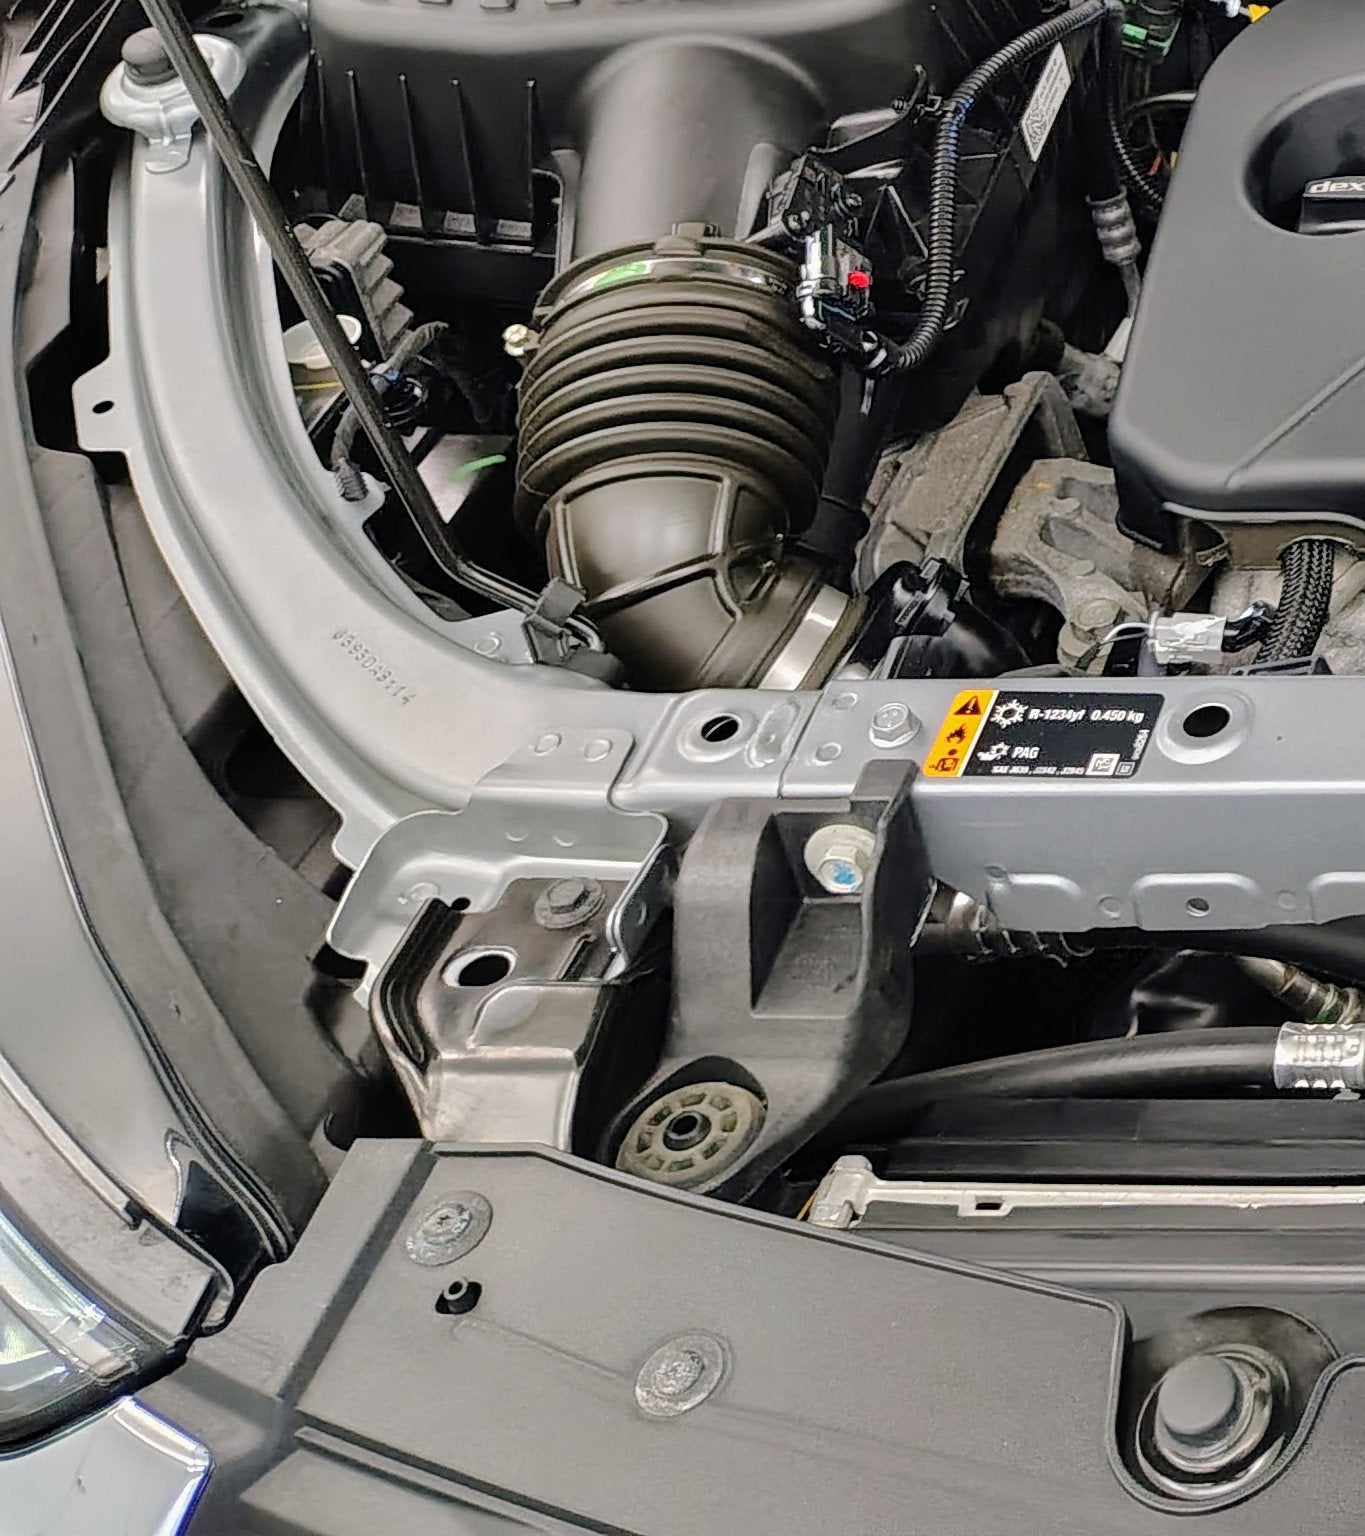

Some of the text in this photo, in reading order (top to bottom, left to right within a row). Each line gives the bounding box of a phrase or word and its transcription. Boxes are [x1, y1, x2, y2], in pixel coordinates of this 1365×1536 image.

[1028, 709, 1144, 724] R-1234yf 0.450 kg
[1011, 746, 1040, 759] PAG
